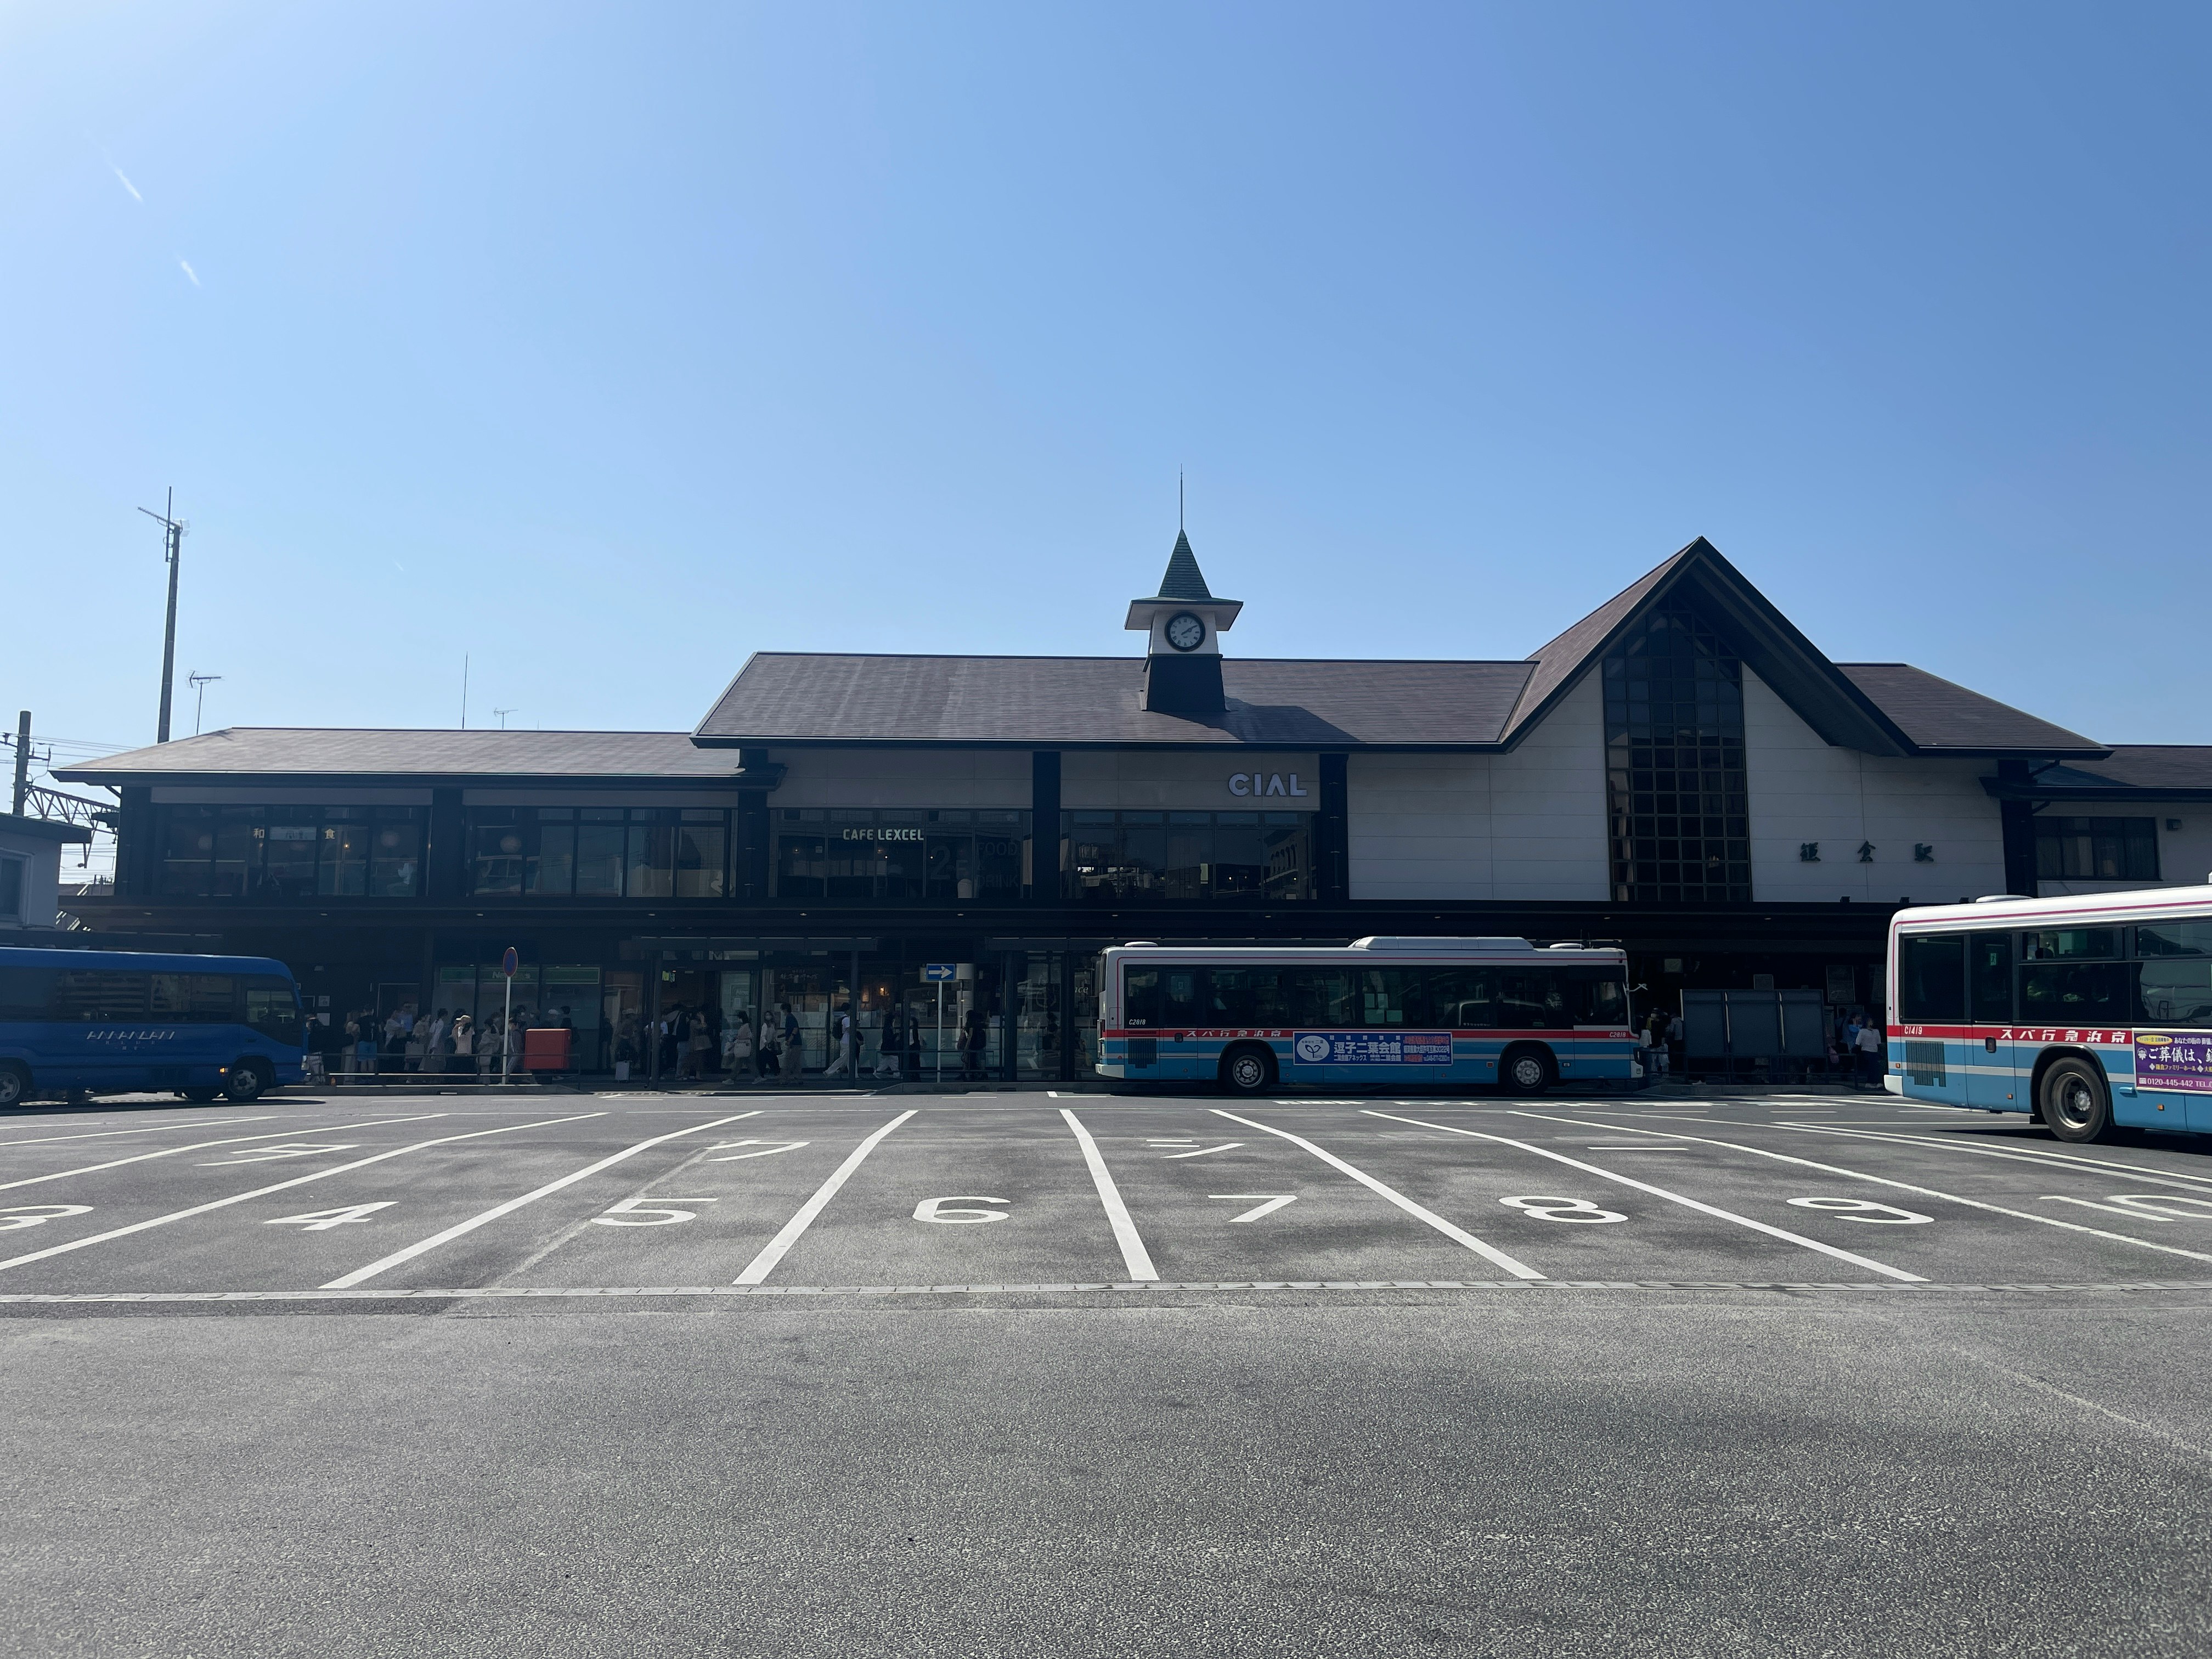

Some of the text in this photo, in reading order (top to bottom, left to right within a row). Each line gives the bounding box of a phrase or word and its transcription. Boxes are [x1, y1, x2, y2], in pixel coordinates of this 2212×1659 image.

[1228, 773, 1307, 797] CIAL
[843, 828, 924, 841] CAFE LEXCEL
[976, 842, 1018, 856] FOOD
[976, 874, 1019, 888] DRINK
[1904, 1026, 1922, 1035] C1419
[1334, 1042, 1401, 1054] 逗子二葉会館
[2147, 1077, 2193, 1087] 0120-445-442
[264, 1201, 399, 1231] 4
[591, 1197, 718, 1227] 5
[912, 1195, 1011, 1224] 6
[1207, 1194, 1297, 1223] 7
[1498, 1195, 1629, 1224] 8
[1786, 1197, 1934, 1224] 9
